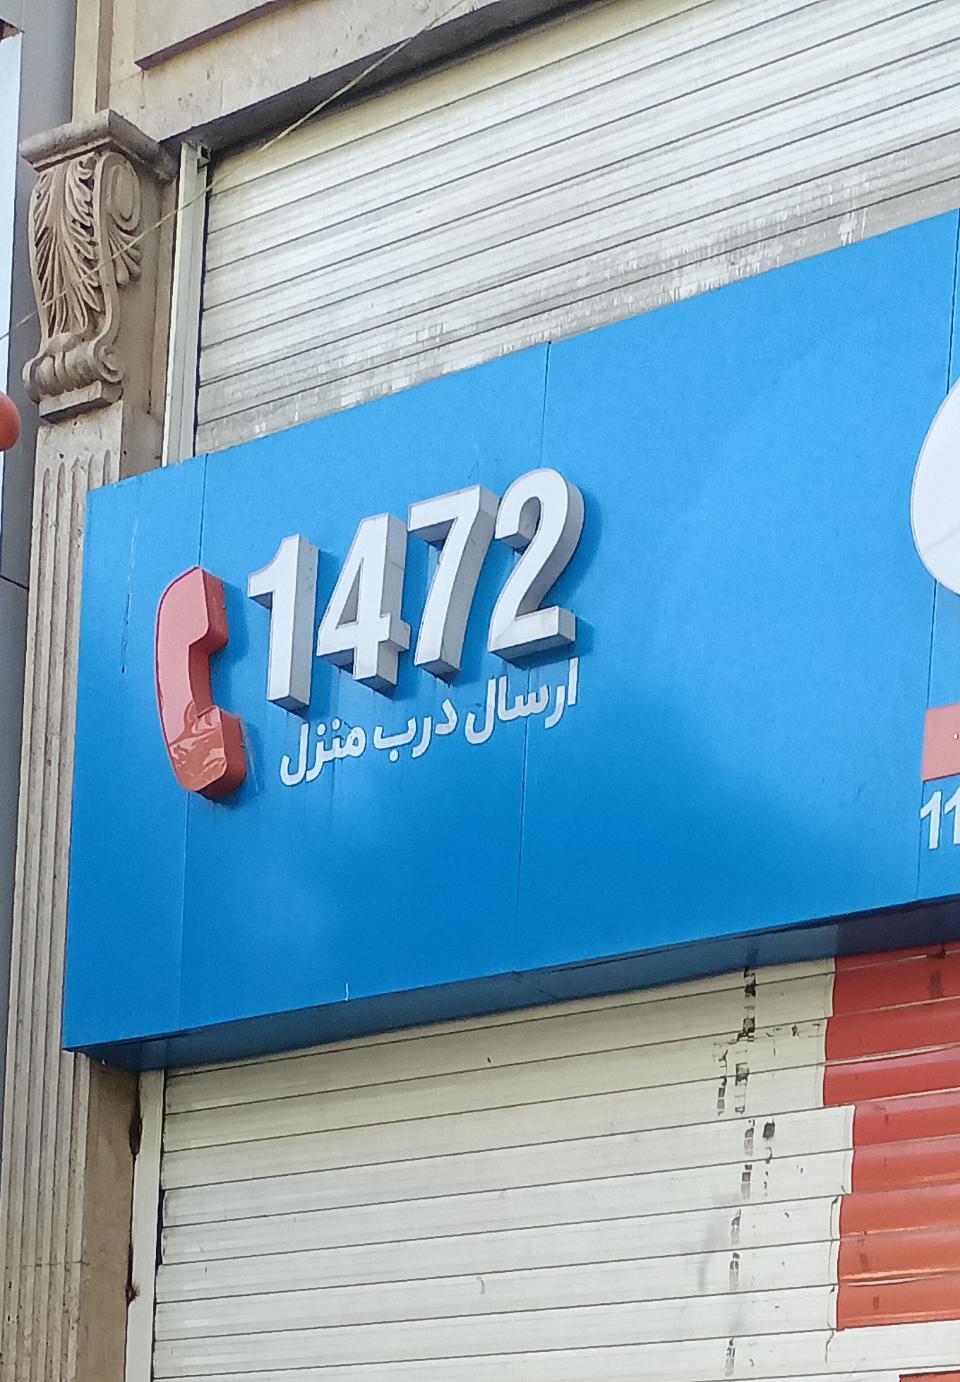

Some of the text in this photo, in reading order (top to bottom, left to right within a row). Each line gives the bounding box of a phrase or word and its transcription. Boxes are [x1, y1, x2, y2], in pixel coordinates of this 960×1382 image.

[247, 467, 585, 714] 1472
[280, 656, 579, 786] ارسال درب منزل
